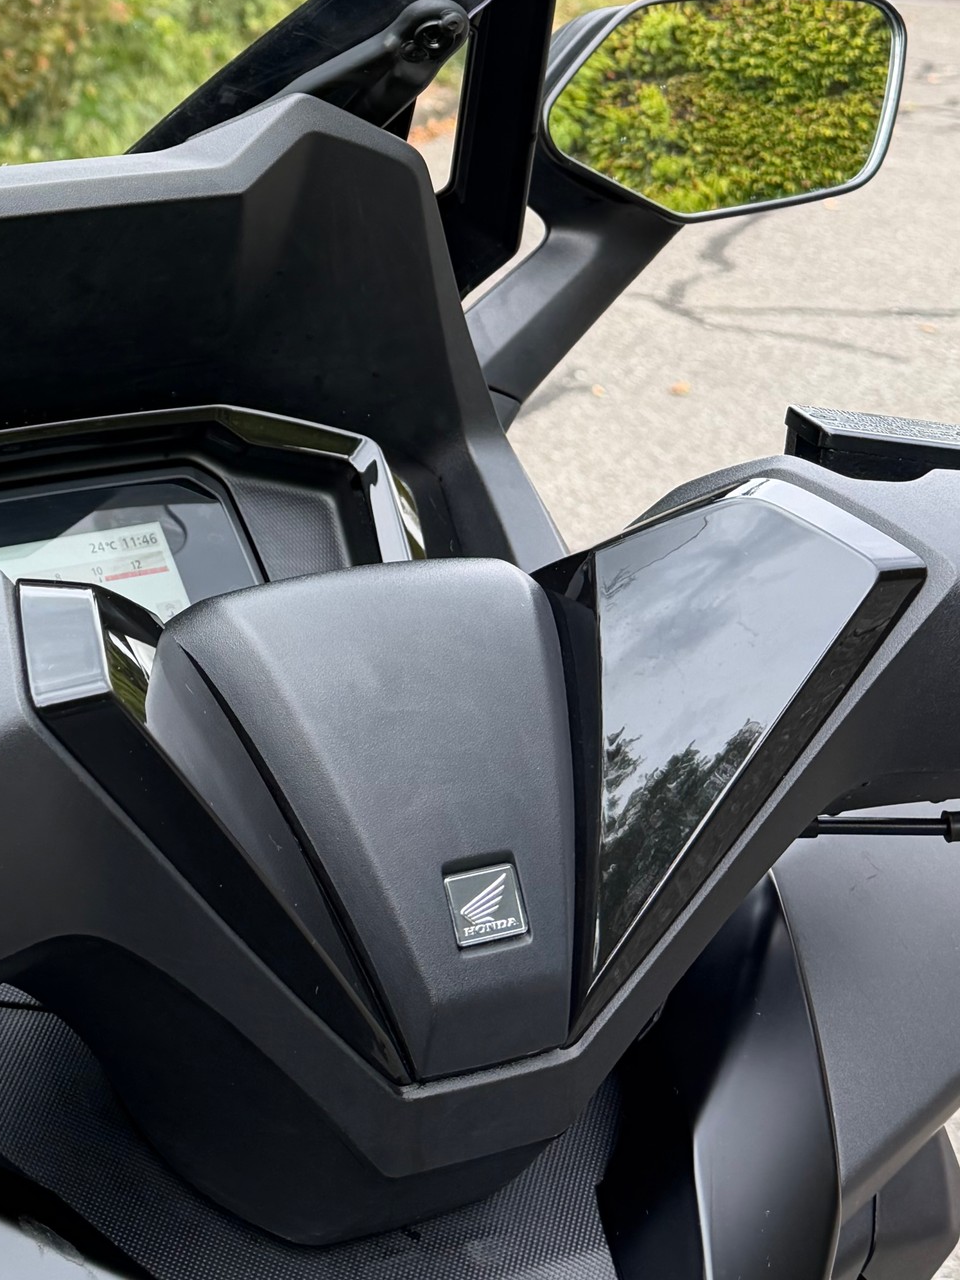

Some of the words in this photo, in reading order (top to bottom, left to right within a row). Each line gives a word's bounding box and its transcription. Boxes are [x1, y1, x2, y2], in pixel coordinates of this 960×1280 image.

[121, 532, 158, 550] 11:46
[92, 566, 103, 576] 10
[130, 560, 142, 570] 12
[463, 917, 519, 937] HONDA
